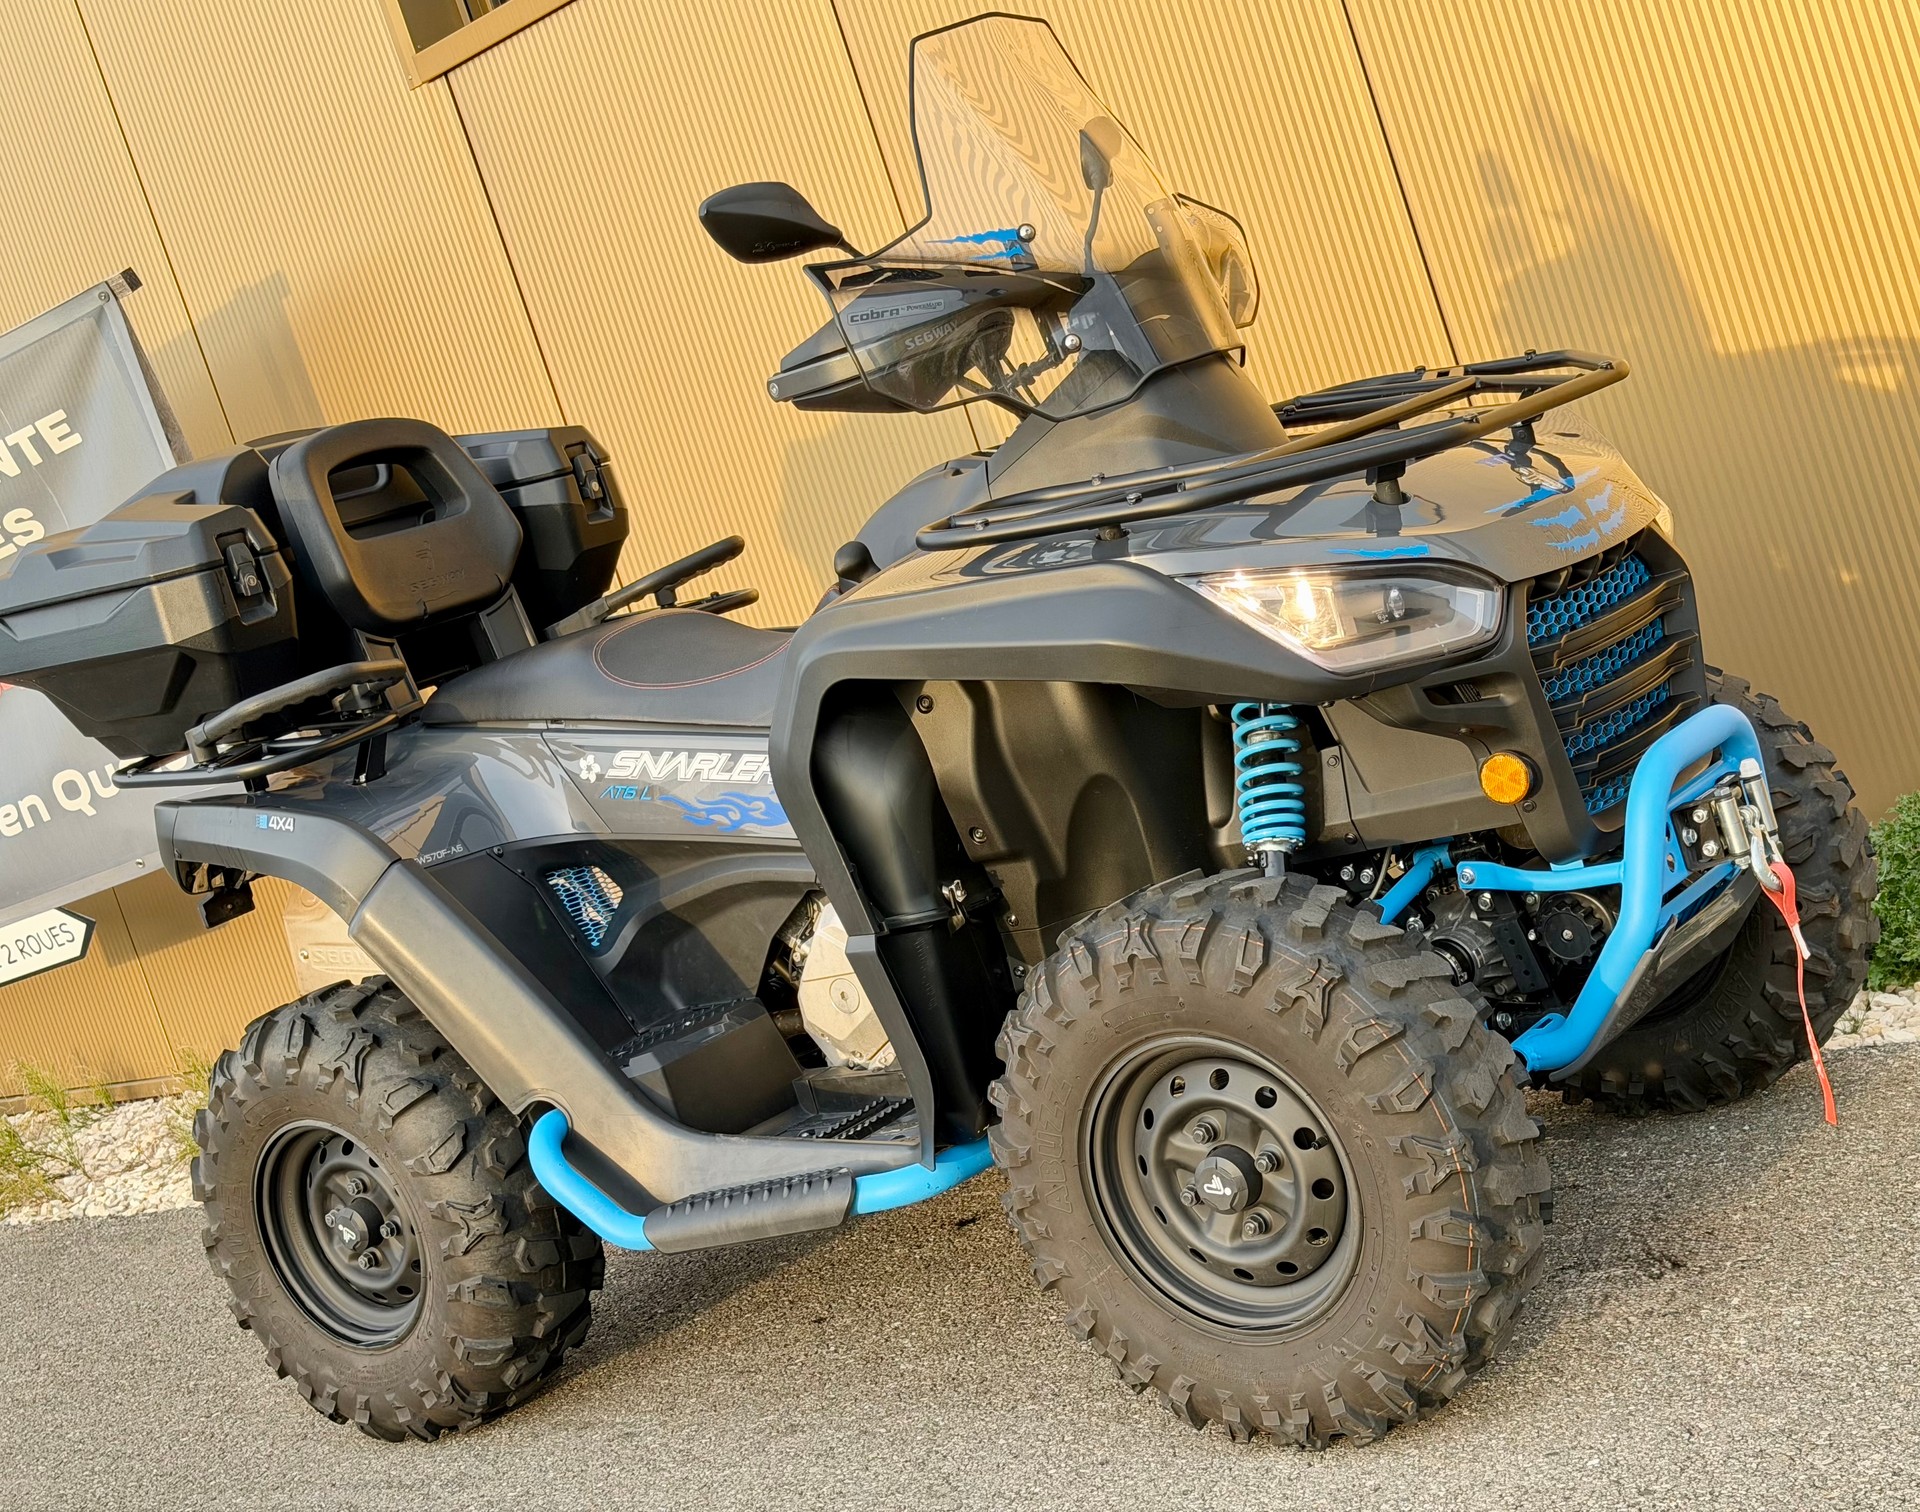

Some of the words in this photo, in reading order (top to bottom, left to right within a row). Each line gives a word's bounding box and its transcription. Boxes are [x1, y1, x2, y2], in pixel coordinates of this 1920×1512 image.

[850, 307, 900, 323] cobra
[904, 320, 960, 350] SEGWAY
[600, 785, 638, 799] AT6
[639, 786, 653, 800] L
[0, 794, 51, 837] en
[269, 815, 294, 832] 4X4
[1, 944, 18, 964] 2
[15, 923, 75, 960] ROUES
[1036, 1070, 1074, 1215] ABUZZ
